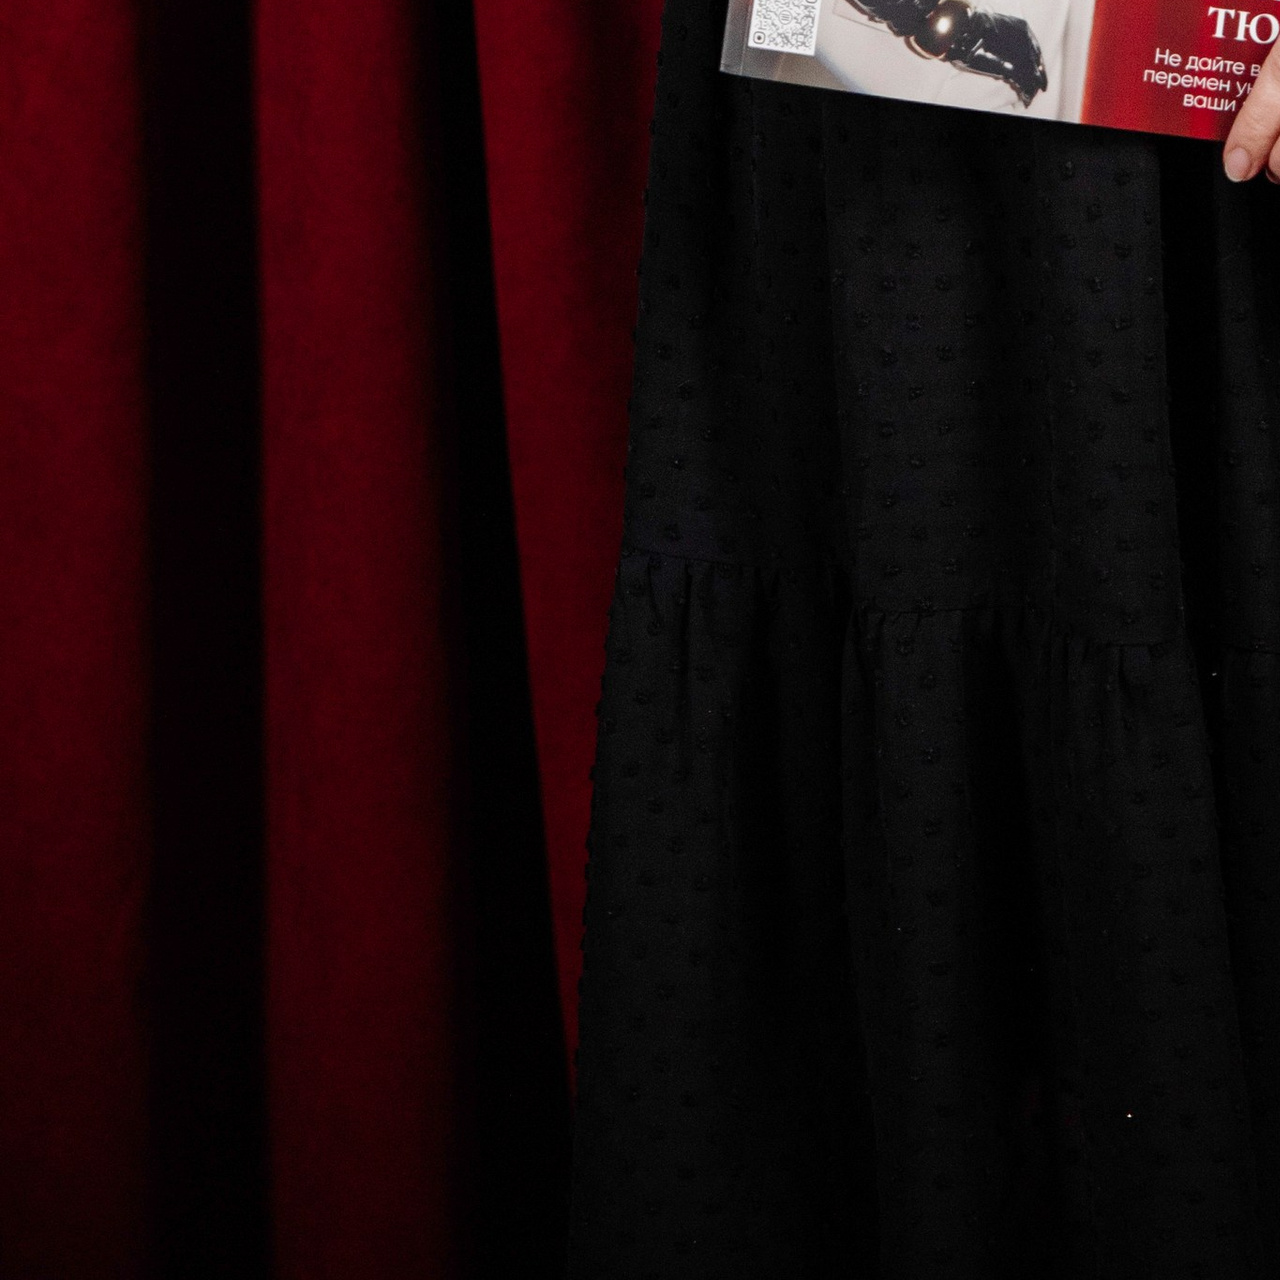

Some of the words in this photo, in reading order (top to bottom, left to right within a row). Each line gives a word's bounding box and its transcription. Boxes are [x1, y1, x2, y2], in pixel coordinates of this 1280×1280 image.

[1207, 6, 1280, 45] ТЮ
[1154, 47, 1182, 67] Не
[1185, 55, 1246, 76] дайте
[1143, 69, 1231, 93] перемен
[1183, 93, 1236, 112] ваши
